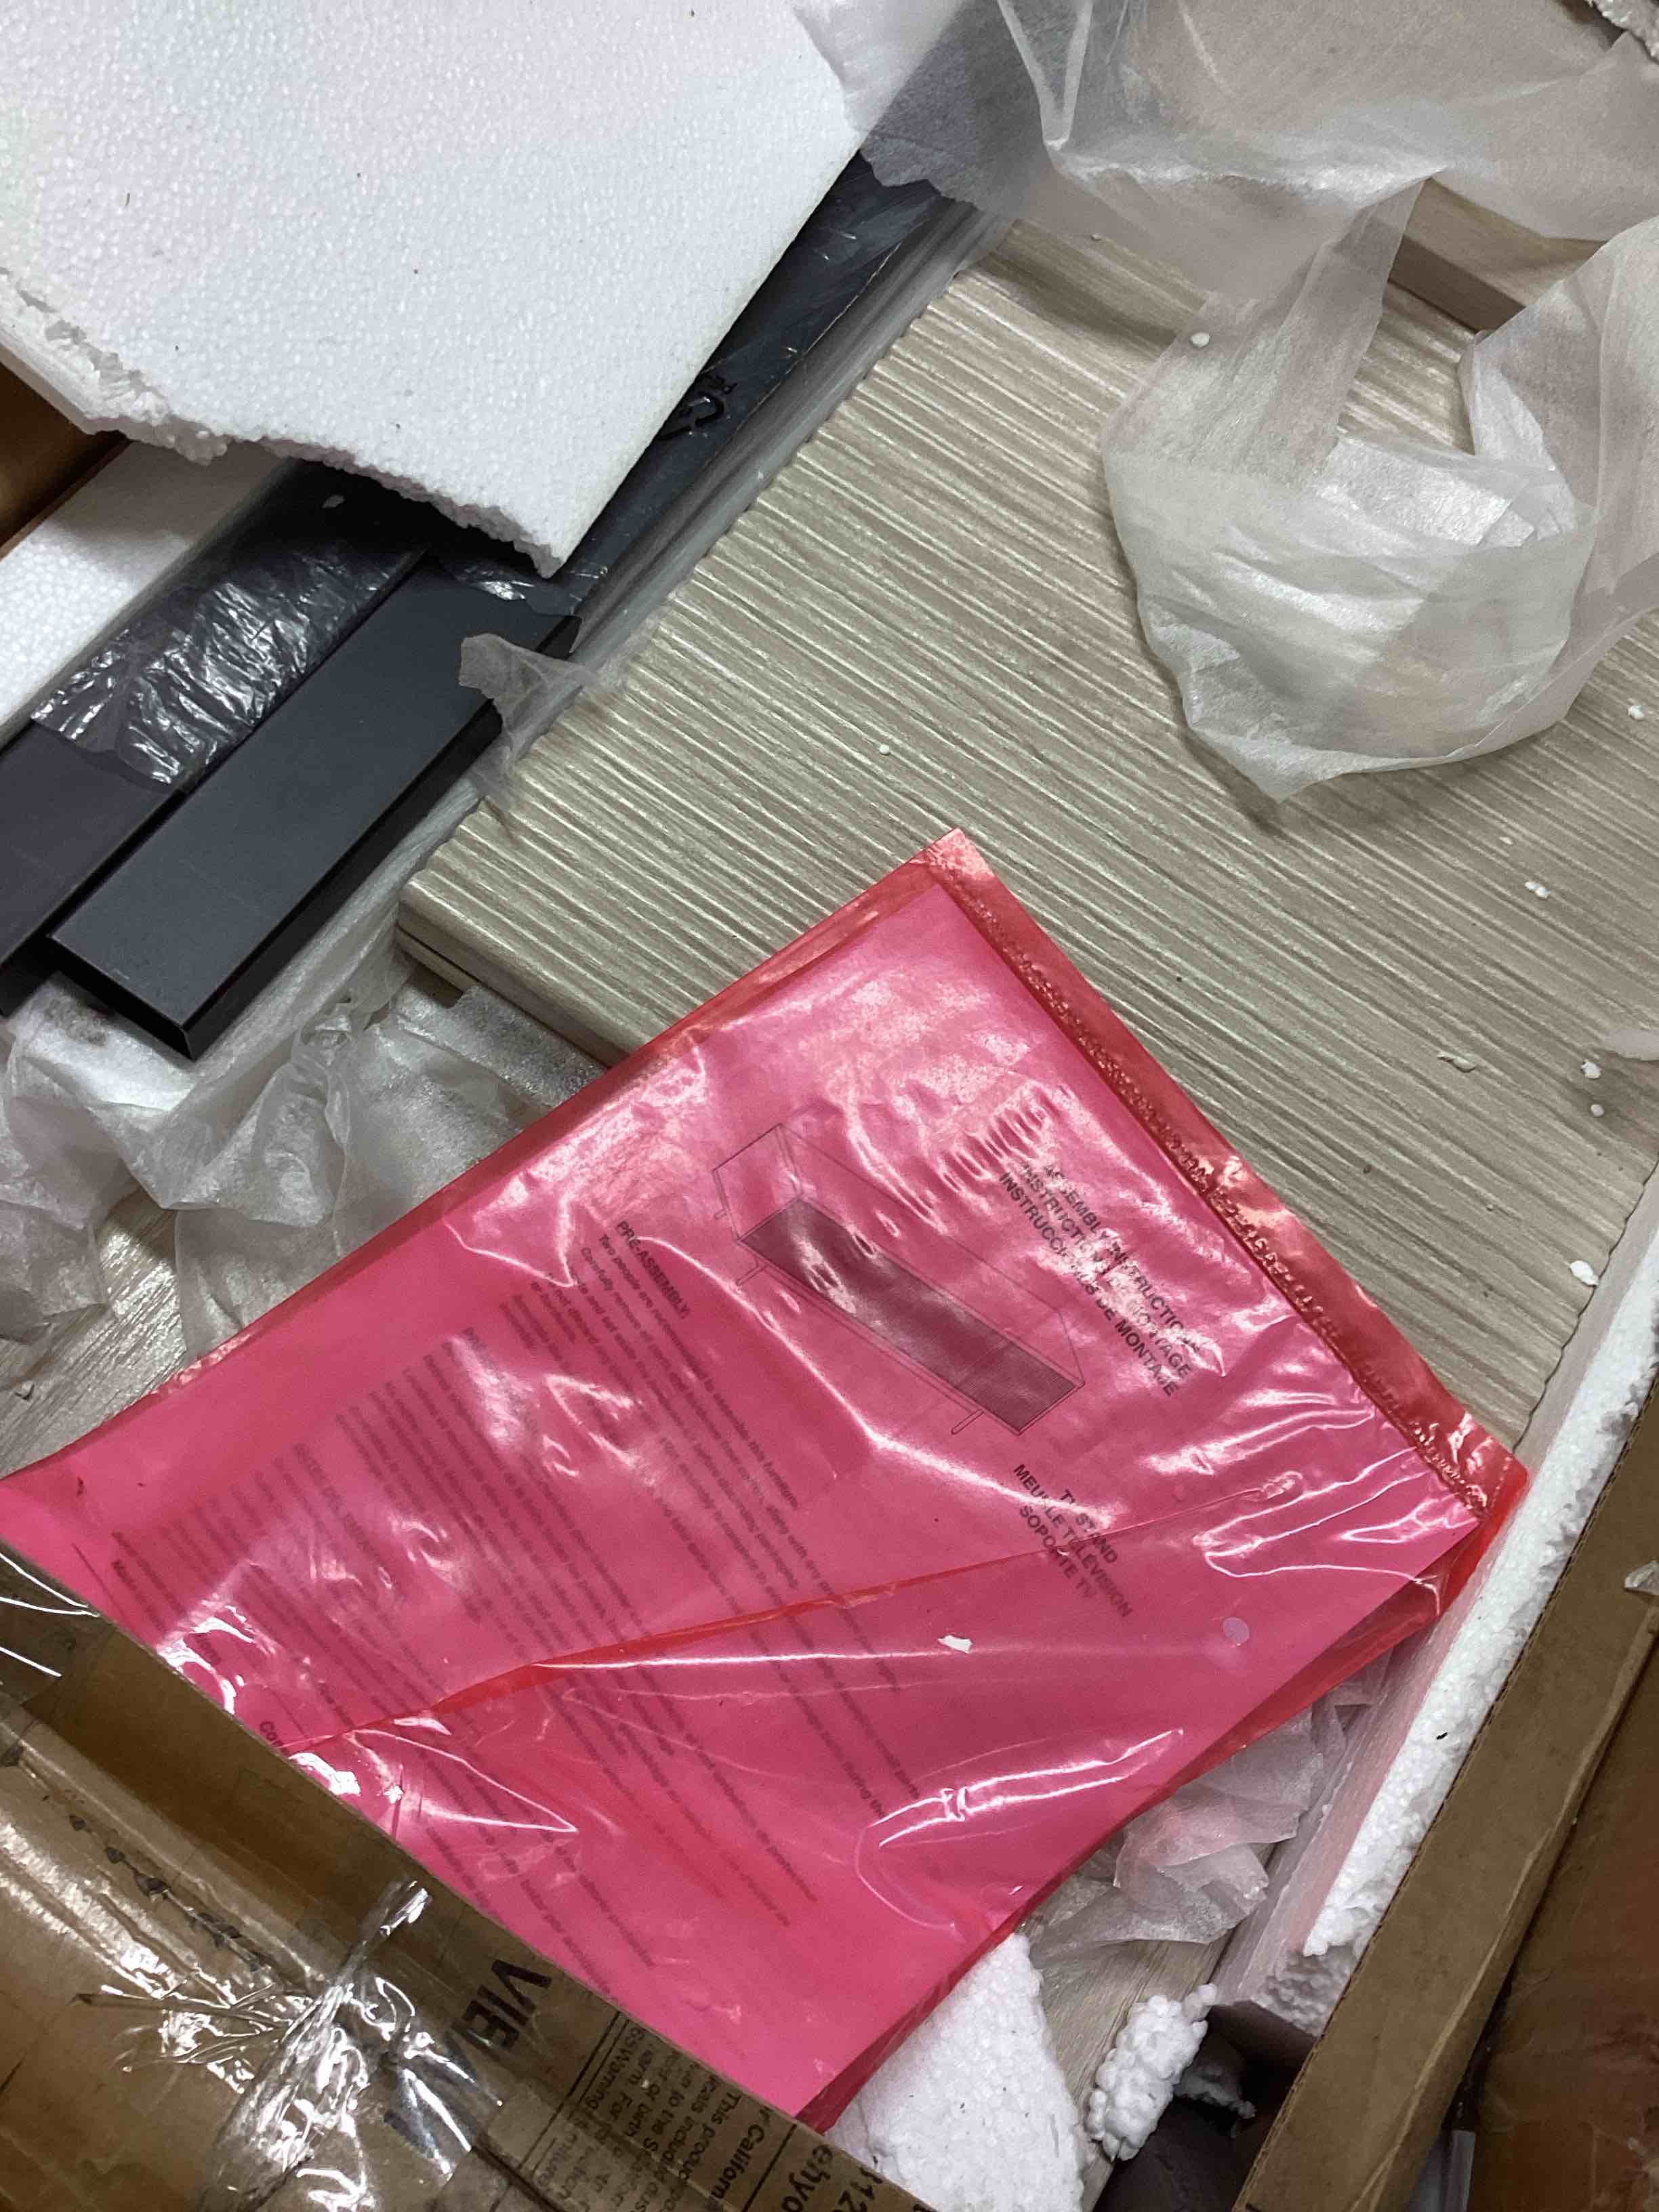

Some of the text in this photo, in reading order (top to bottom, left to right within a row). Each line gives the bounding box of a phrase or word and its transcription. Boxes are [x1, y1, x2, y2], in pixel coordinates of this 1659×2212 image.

[1000, 1172, 1101, 1296] INSTRUCCINES
[1105, 1244, 1202, 1357] INSTRUCTIOS
[1013, 1464, 1066, 1528] MEULE
